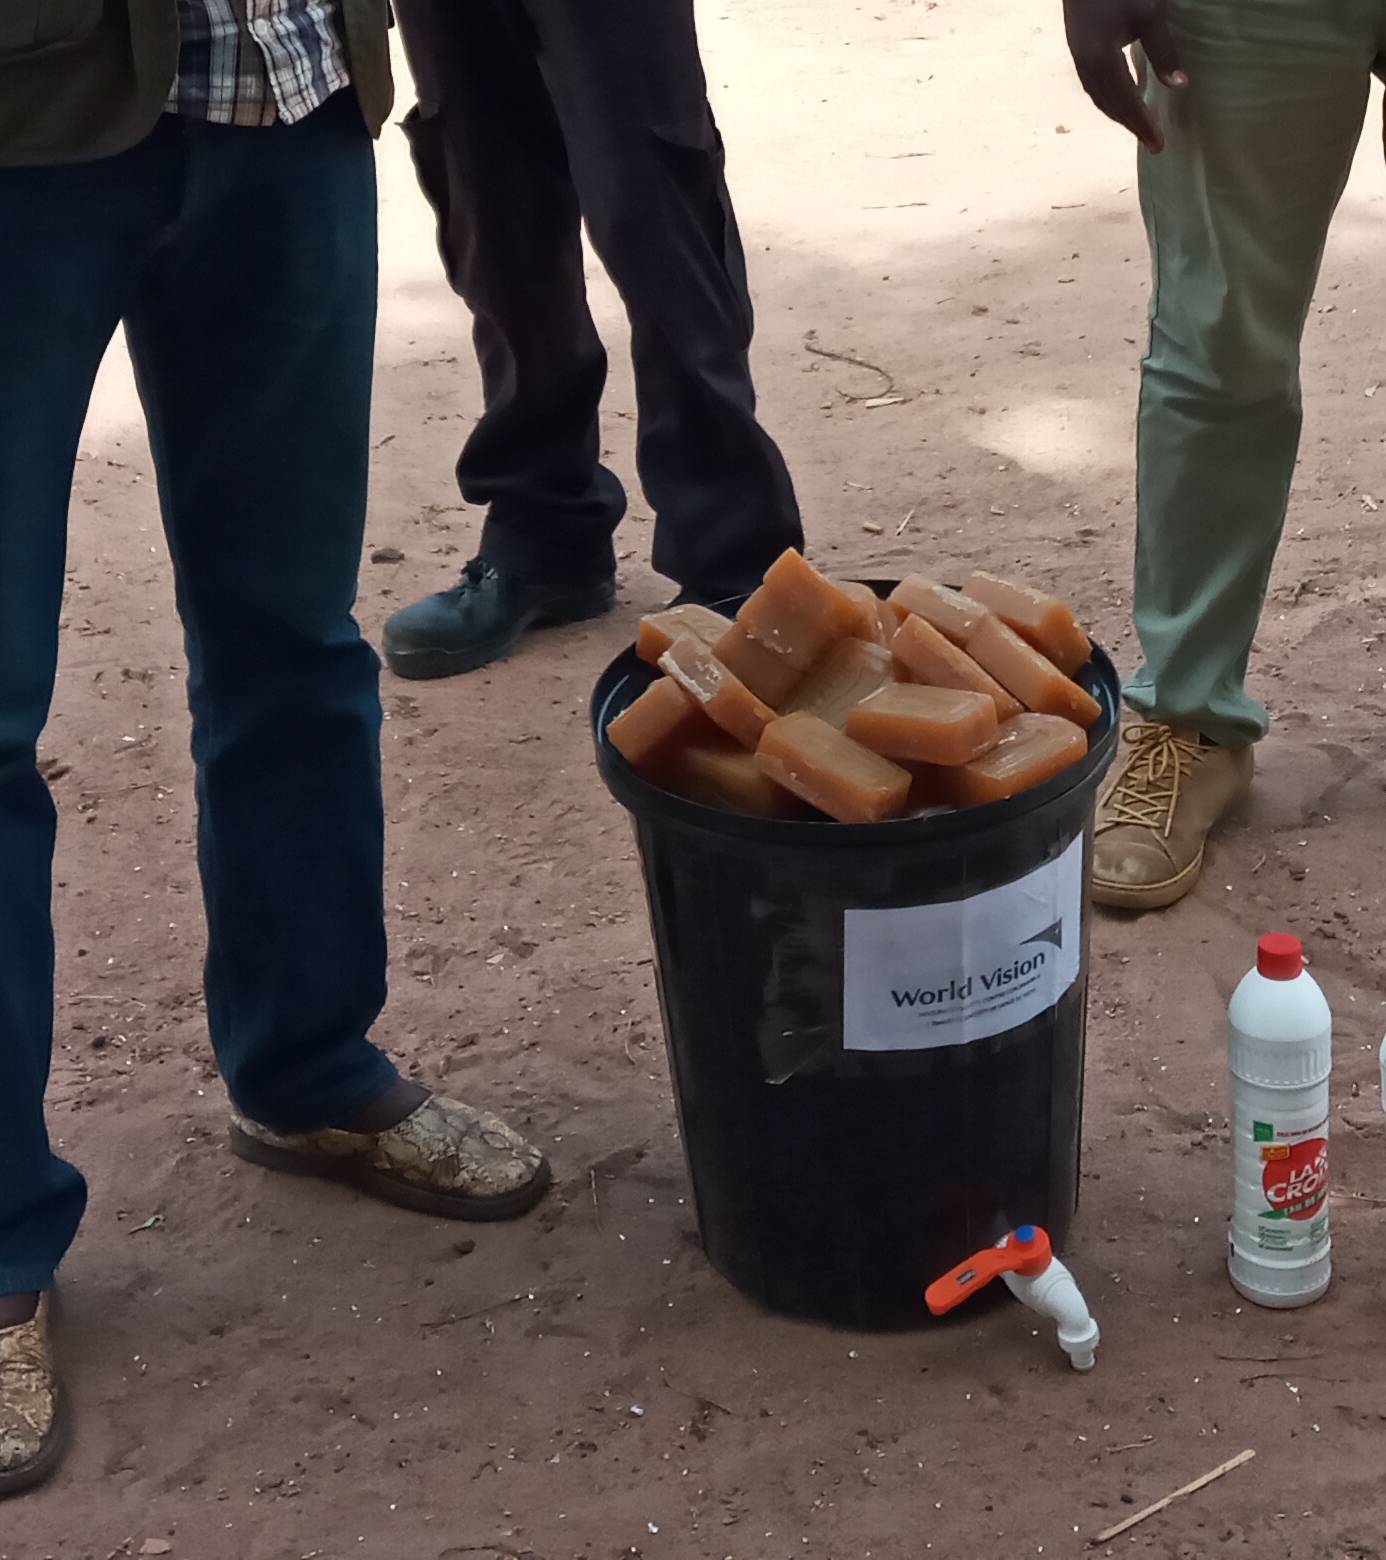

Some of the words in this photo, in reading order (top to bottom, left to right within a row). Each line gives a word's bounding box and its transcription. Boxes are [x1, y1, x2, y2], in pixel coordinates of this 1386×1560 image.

[890, 976, 973, 1009] World
[979, 951, 1046, 992] Vision
[1289, 1163, 1313, 1184] LA
